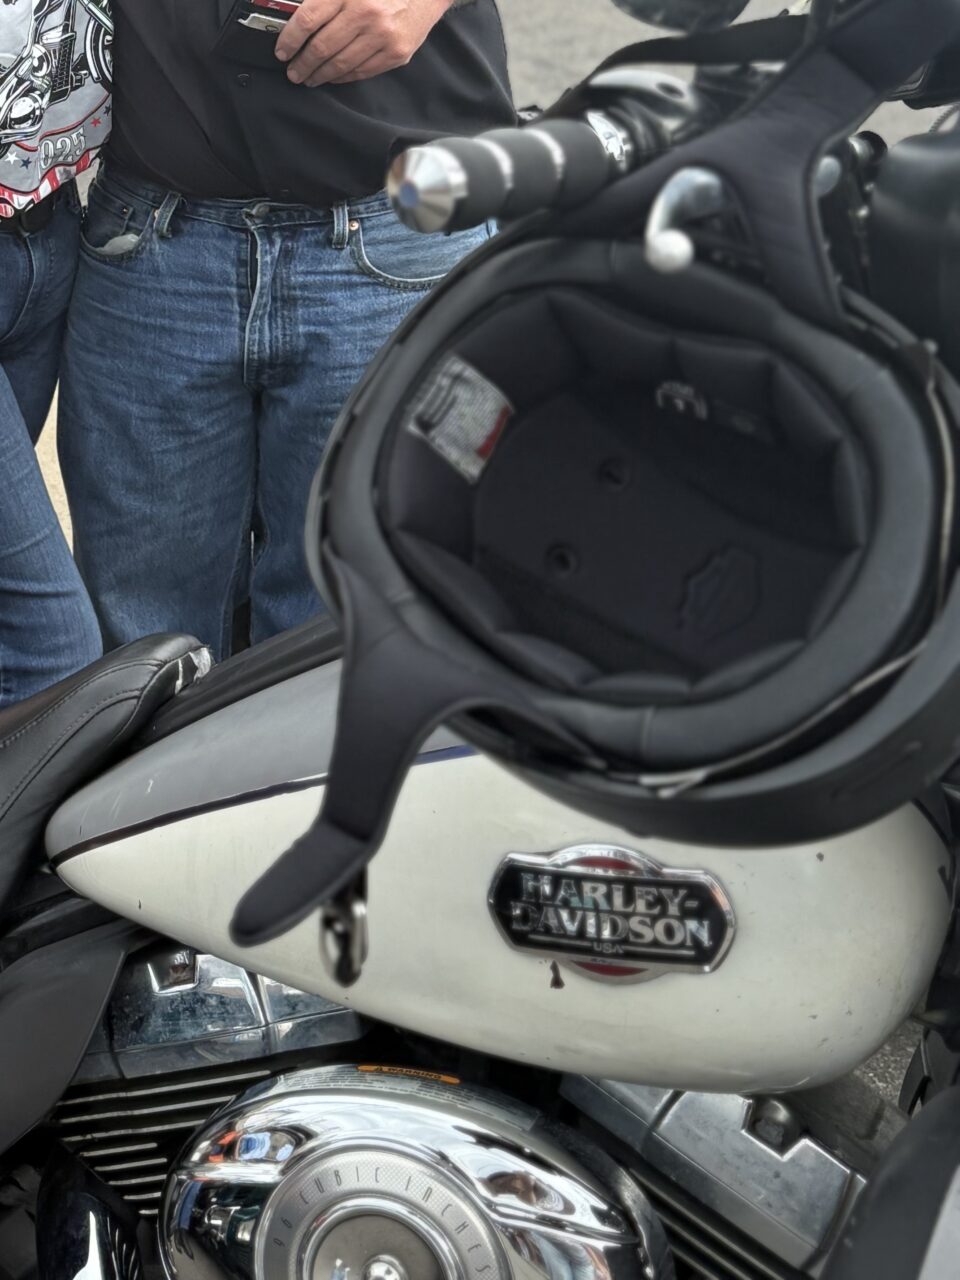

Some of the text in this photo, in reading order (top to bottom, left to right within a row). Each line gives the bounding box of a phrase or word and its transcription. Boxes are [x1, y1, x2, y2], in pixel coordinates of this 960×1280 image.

[520, 872, 699, 917] HARLEY-
[510, 900, 711, 947] DAVIDSON
[592, 941, 625, 954] USA
[387, 1067, 442, 1080] WARNING
[298, 1166, 380, 1205] CUBIC
[404, 1175, 492, 1273] INCHES
